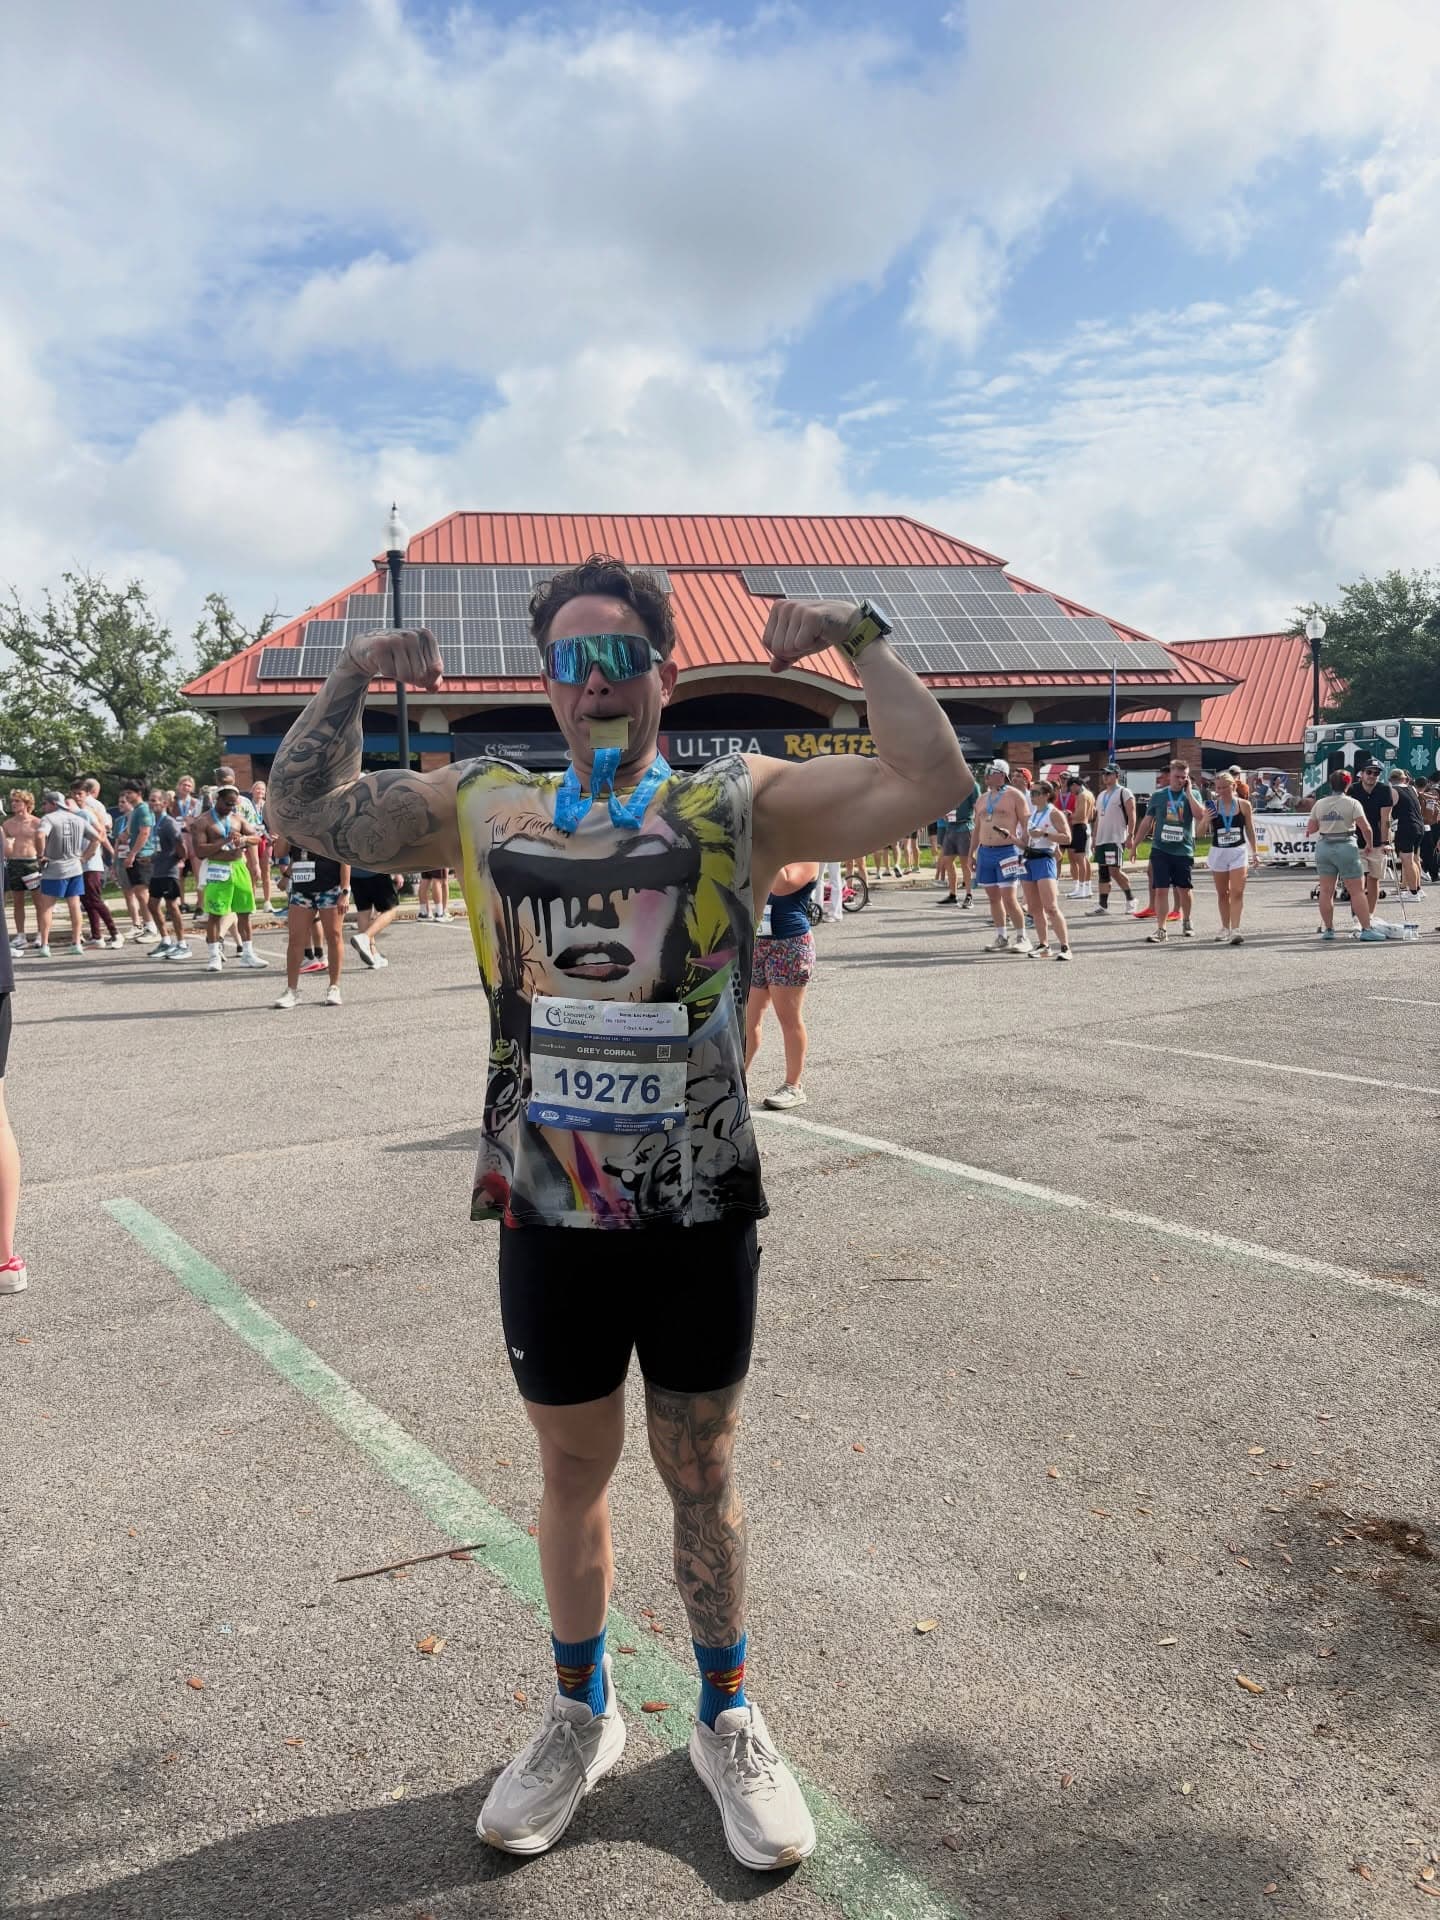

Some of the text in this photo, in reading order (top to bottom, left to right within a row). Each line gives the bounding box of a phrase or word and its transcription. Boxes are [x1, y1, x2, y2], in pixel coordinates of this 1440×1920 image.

[677, 737, 762, 757] ULTRA
[577, 1046, 637, 1057] GREY CORRAL
[554, 1068, 661, 1105] 19276
